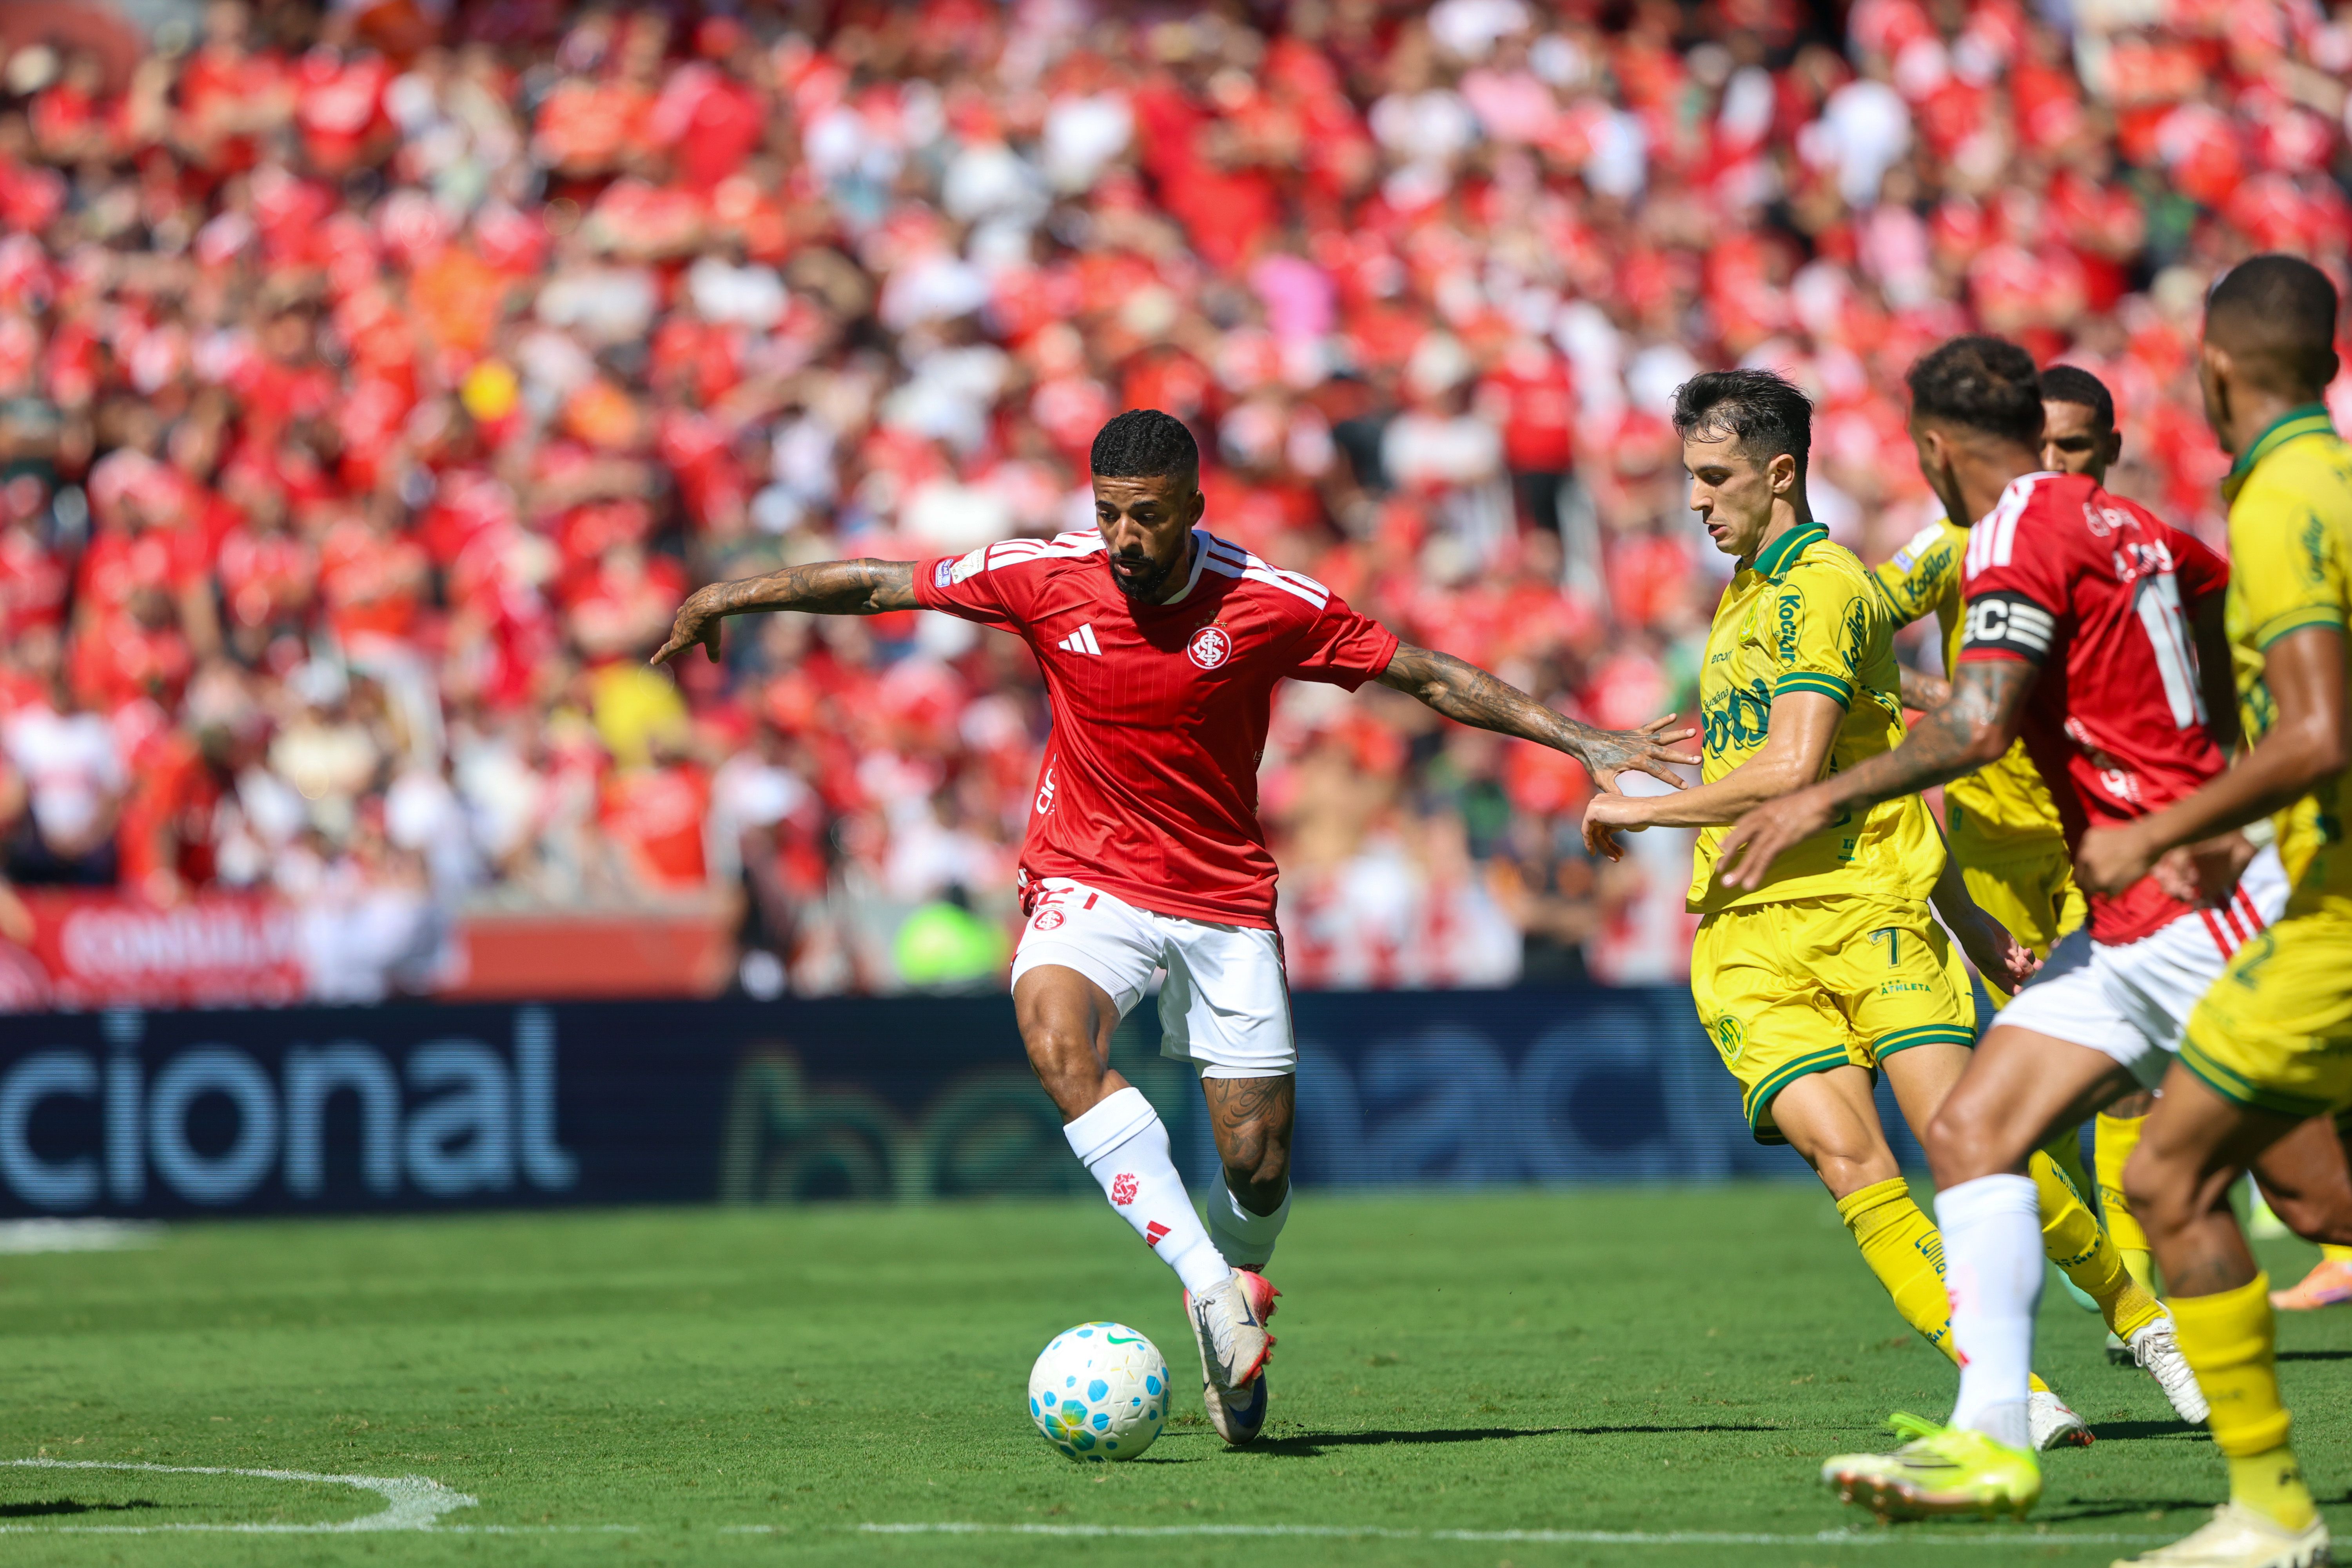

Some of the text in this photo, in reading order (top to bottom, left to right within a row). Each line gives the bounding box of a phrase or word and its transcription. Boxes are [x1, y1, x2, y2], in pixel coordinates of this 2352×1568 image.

[1974, 599, 2009, 641] C
[1867, 926, 1900, 969] 7
[1881, 983, 1932, 996] ATHLETA
